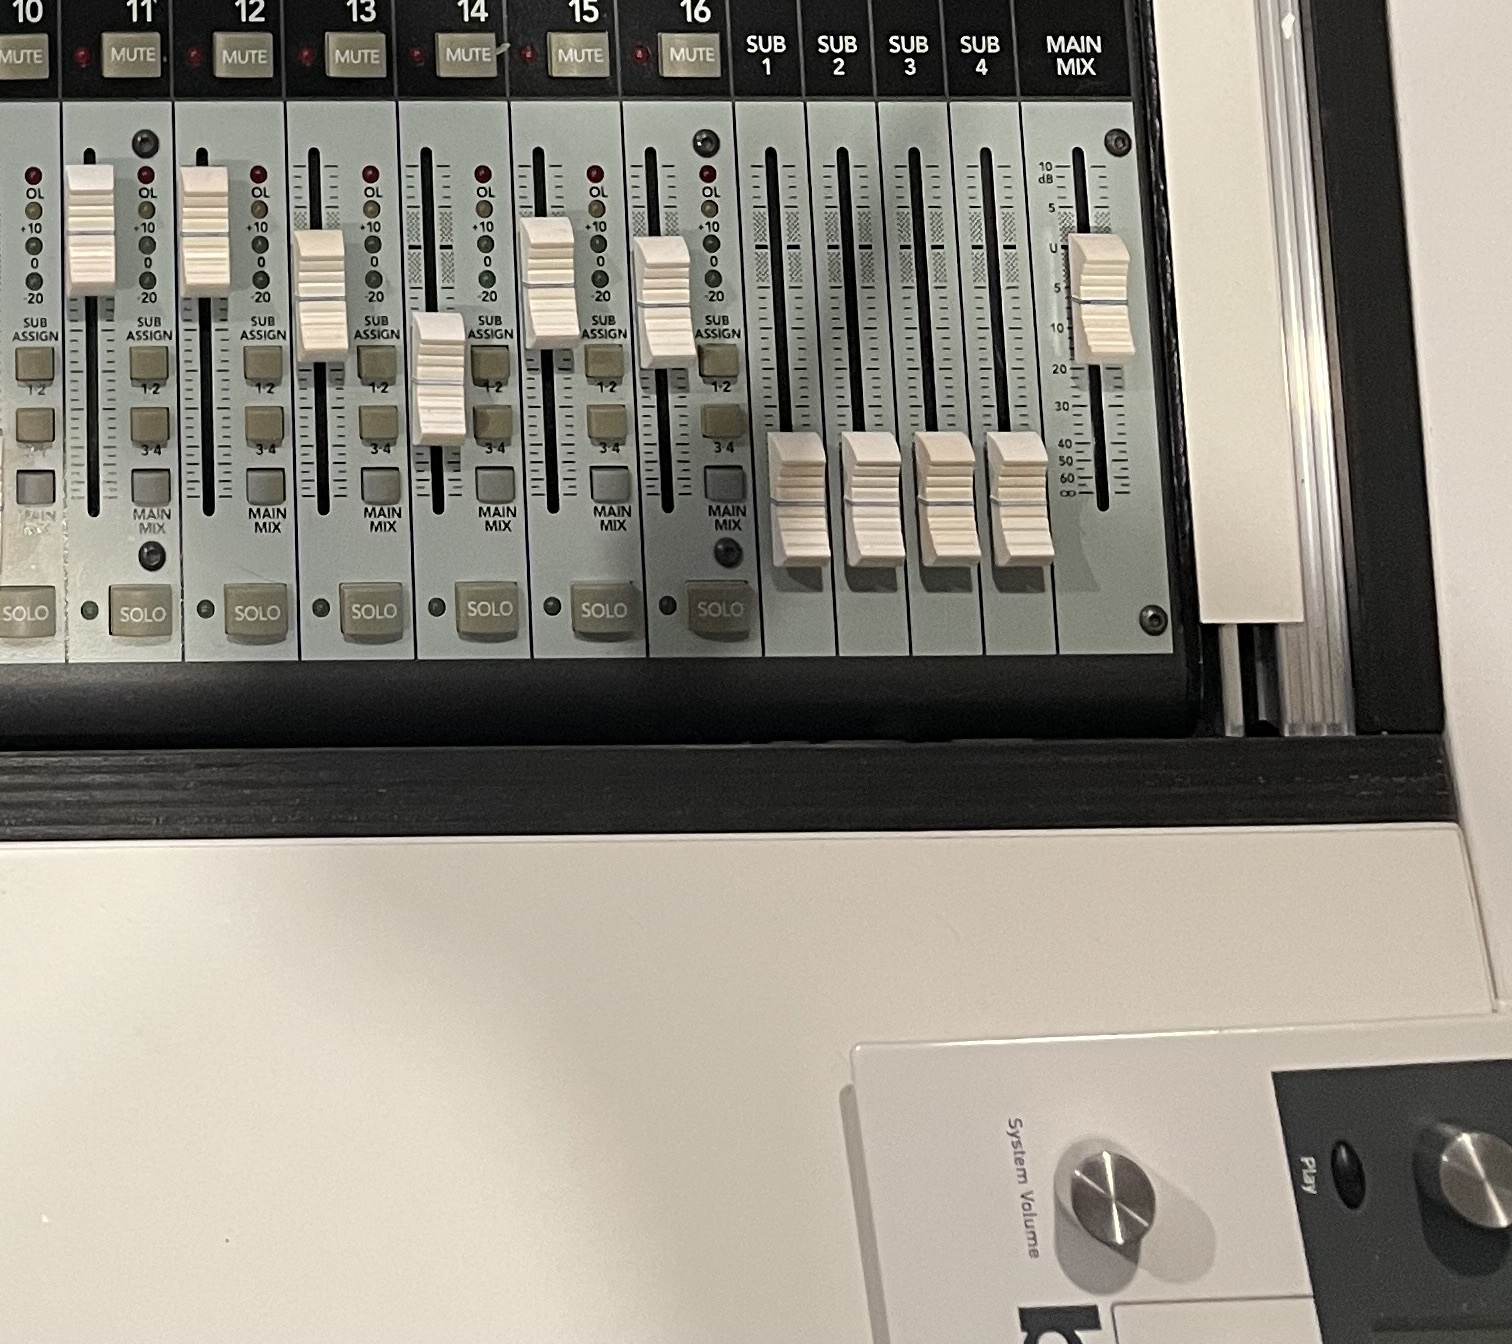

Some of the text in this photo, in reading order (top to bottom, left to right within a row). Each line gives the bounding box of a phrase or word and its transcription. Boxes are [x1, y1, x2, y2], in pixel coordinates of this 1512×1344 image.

[747, 35, 786, 53] SUB
[818, 35, 857, 53] SUB
[889, 36, 928, 53] SUB
[961, 36, 1000, 53] SUB
[1047, 36, 1101, 53] MAIN
[670, 47, 714, 62] MUTE
[763, 58, 770, 75] 1
[833, 58, 845, 75] 2
[905, 58, 916, 75] 3
[976, 59, 988, 75] 4
[1057, 58, 1096, 75] MIX
[139, 187, 157, 198] OL
[251, 316, 275, 326] SUB
[240, 330, 286, 340] ASSIGN
[235, 606, 280, 621] SOLO
[1300, 1155, 1317, 1196] Play
[1007, 1117, 1040, 1259] System Volume
